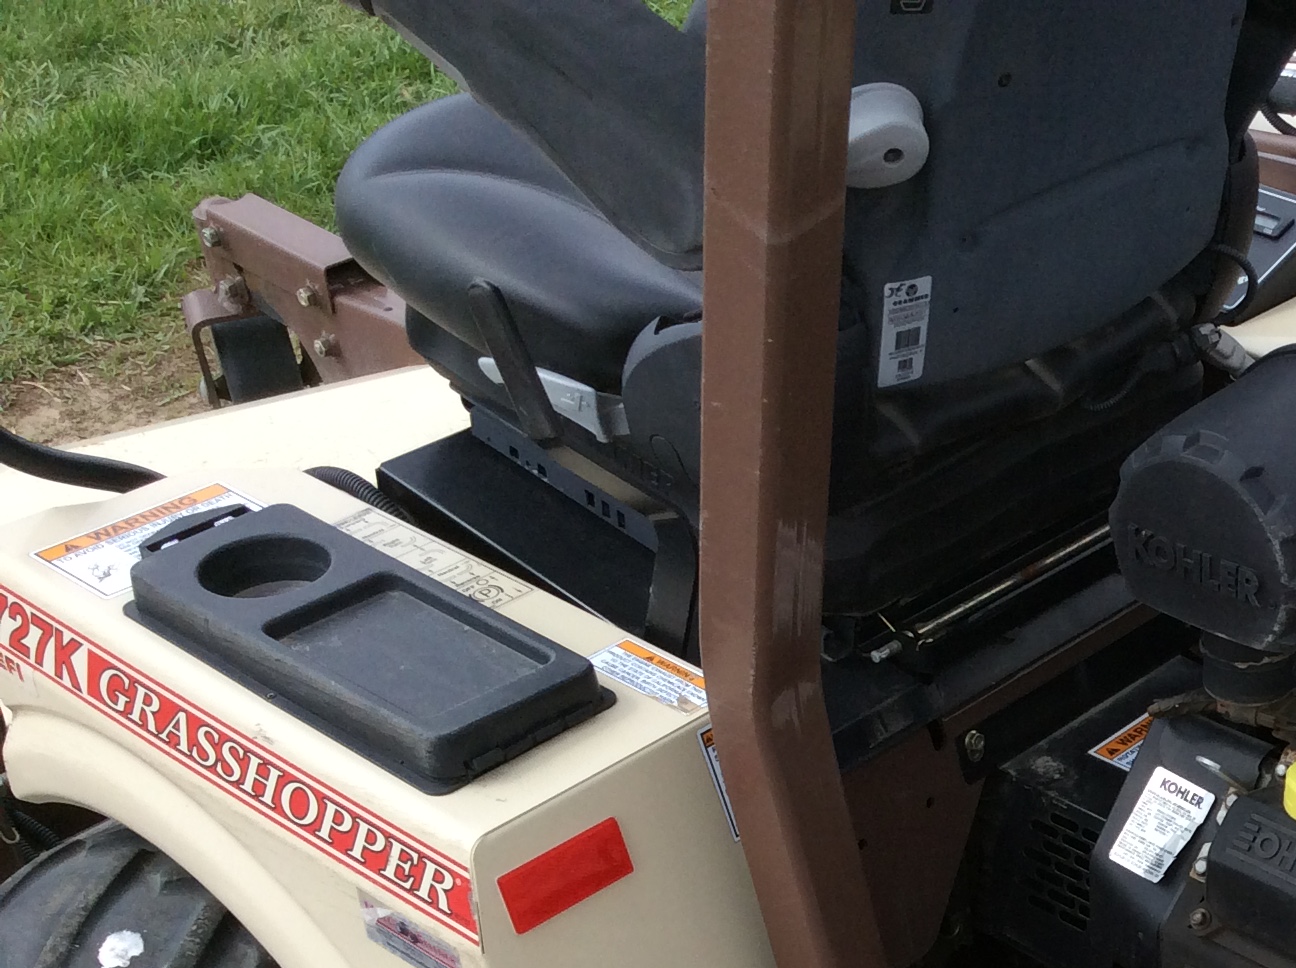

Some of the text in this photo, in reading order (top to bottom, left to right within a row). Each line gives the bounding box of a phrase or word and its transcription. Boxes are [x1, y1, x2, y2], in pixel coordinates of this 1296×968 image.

[86, 496, 198, 541] WARNING
[74, 542, 106, 557] AVOID
[106, 525, 151, 544] SERIOUS
[1127, 522, 1261, 608] KOHLER
[1115, 719, 1151, 746] WARN
[98, 667, 453, 915] GRASSHOPPER
[1159, 776, 1205, 810] KOHLER
